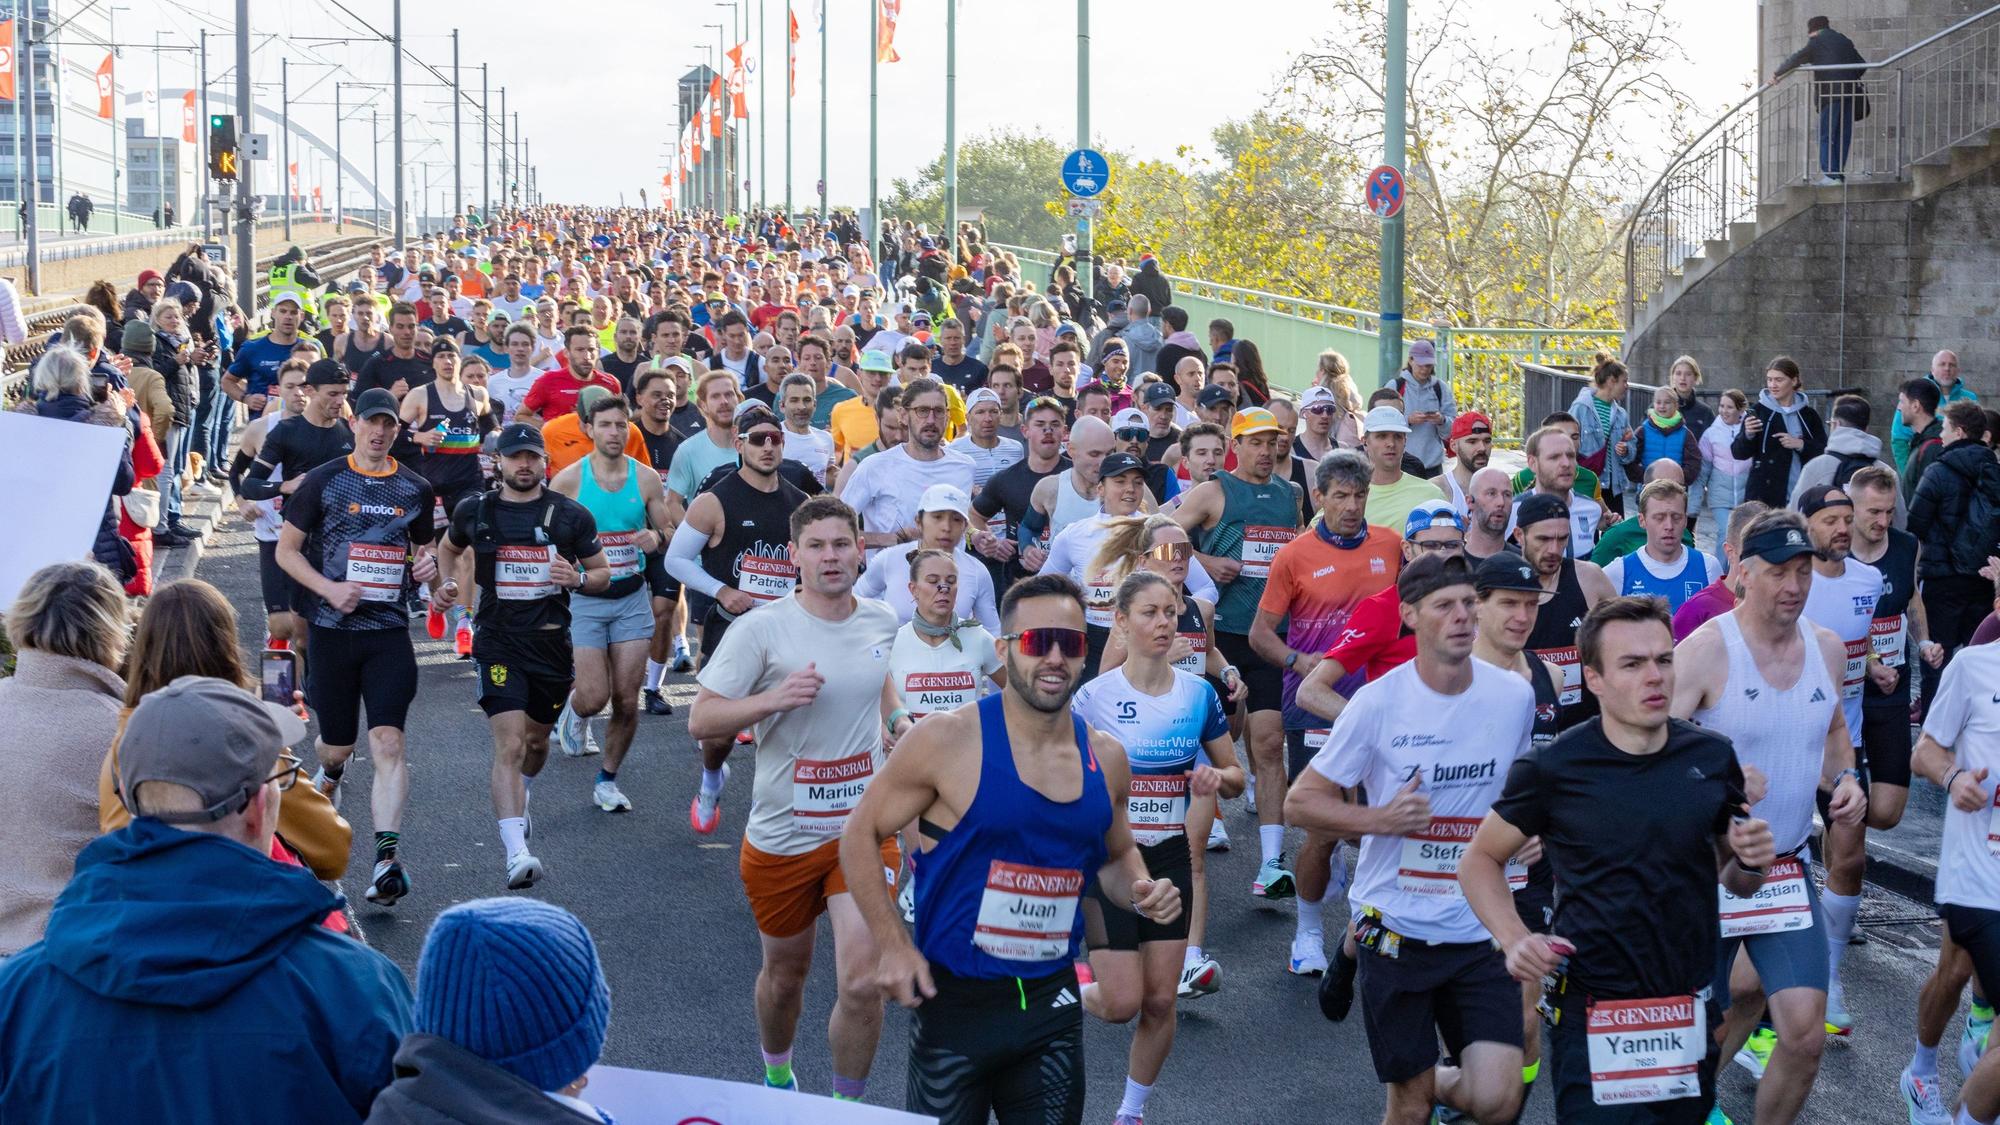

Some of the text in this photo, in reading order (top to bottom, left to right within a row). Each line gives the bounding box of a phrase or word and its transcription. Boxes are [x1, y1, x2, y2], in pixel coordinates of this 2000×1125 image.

[222, 152, 237, 172] K
[446, 427, 473, 435] ACH3
[362, 504, 405, 517] motoin
[364, 549, 405, 561] GENERALI
[503, 549, 548, 561] GENERALI
[607, 546, 635, 557] omas
[352, 561, 402, 576] Sebastian
[504, 563, 540, 575] Flavio
[1312, 564, 1336, 579] HOKA
[749, 574, 789, 589] Patrick
[1870, 620, 1901, 633] ENERALI
[1537, 650, 1578, 662] ENERALI
[922, 675, 973, 688] GENERALI
[920, 692, 963, 704] Alexia
[1136, 748, 1185, 757] NeckarAlb
[816, 758, 872, 779] GENERALI
[1432, 758, 1497, 782] bunert
[808, 783, 865, 800] Marius
[1130, 780, 1185, 792] GENERALI
[1130, 799, 1173, 813] sabel
[1430, 822, 1479, 838] GENER
[1016, 873, 1081, 894] GENERALI
[1009, 897, 1057, 918] Juan
[1613, 1003, 1694, 1026] GENERALI
[1605, 1032, 1685, 1055] Yannik
